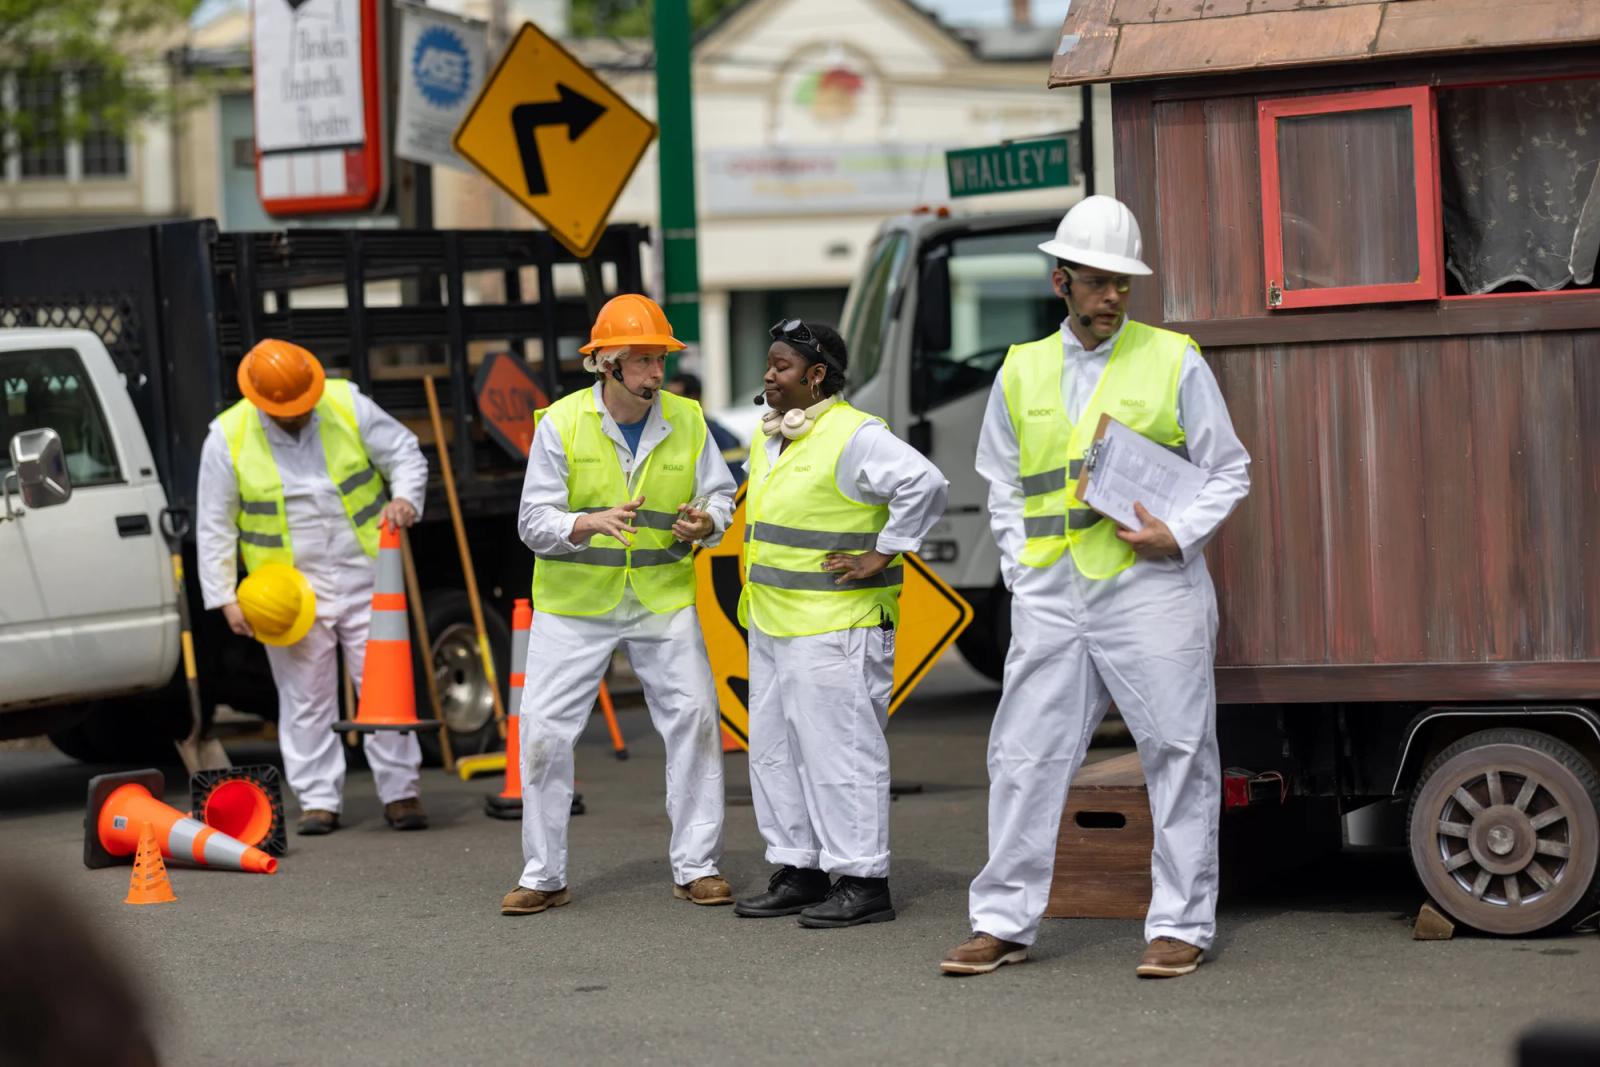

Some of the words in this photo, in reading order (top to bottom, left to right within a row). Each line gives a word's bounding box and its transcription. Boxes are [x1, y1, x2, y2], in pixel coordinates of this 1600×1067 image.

[951, 148, 1046, 191] WHALLEY
[1119, 399, 1146, 407] ROAD
[662, 463, 685, 472] ROAD
